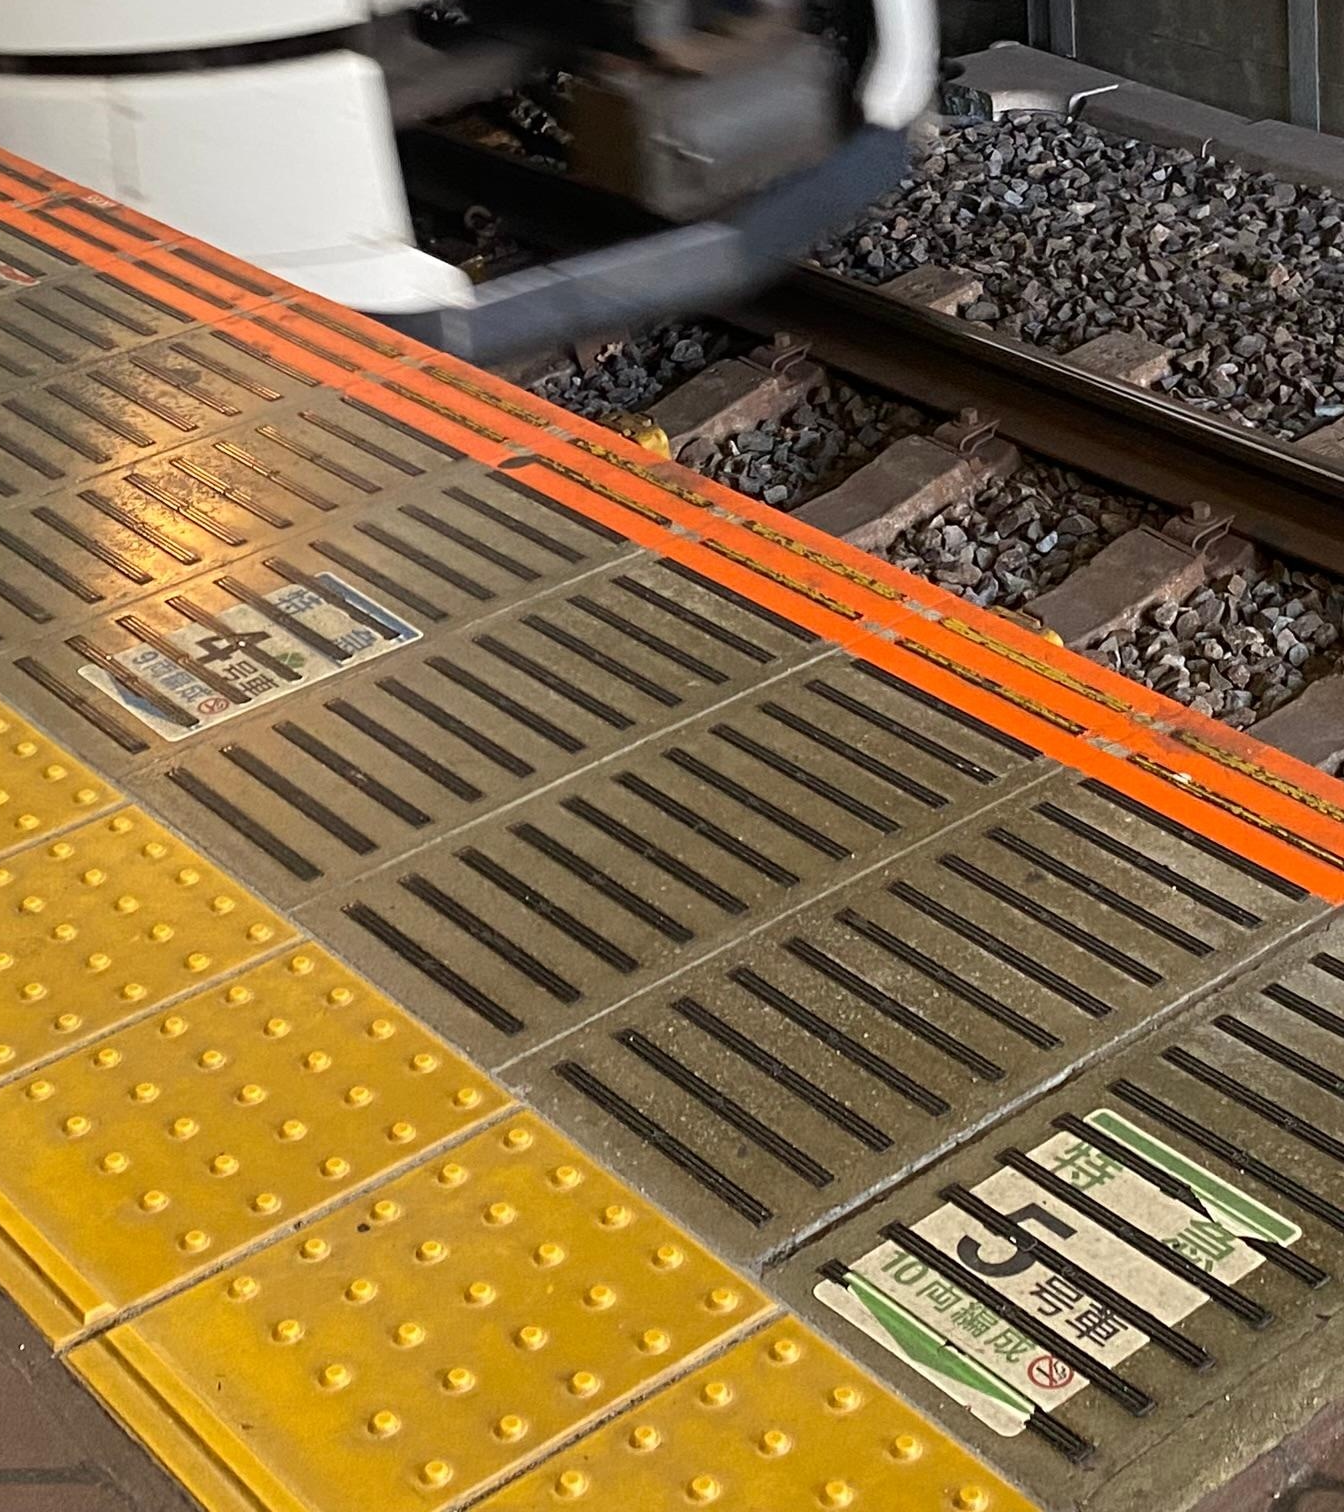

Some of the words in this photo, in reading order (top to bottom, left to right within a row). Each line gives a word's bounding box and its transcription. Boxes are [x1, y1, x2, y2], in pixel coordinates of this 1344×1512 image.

[1052, 1140, 1236, 1274] 特急
[879, 1248, 1037, 1364] 10両編成
